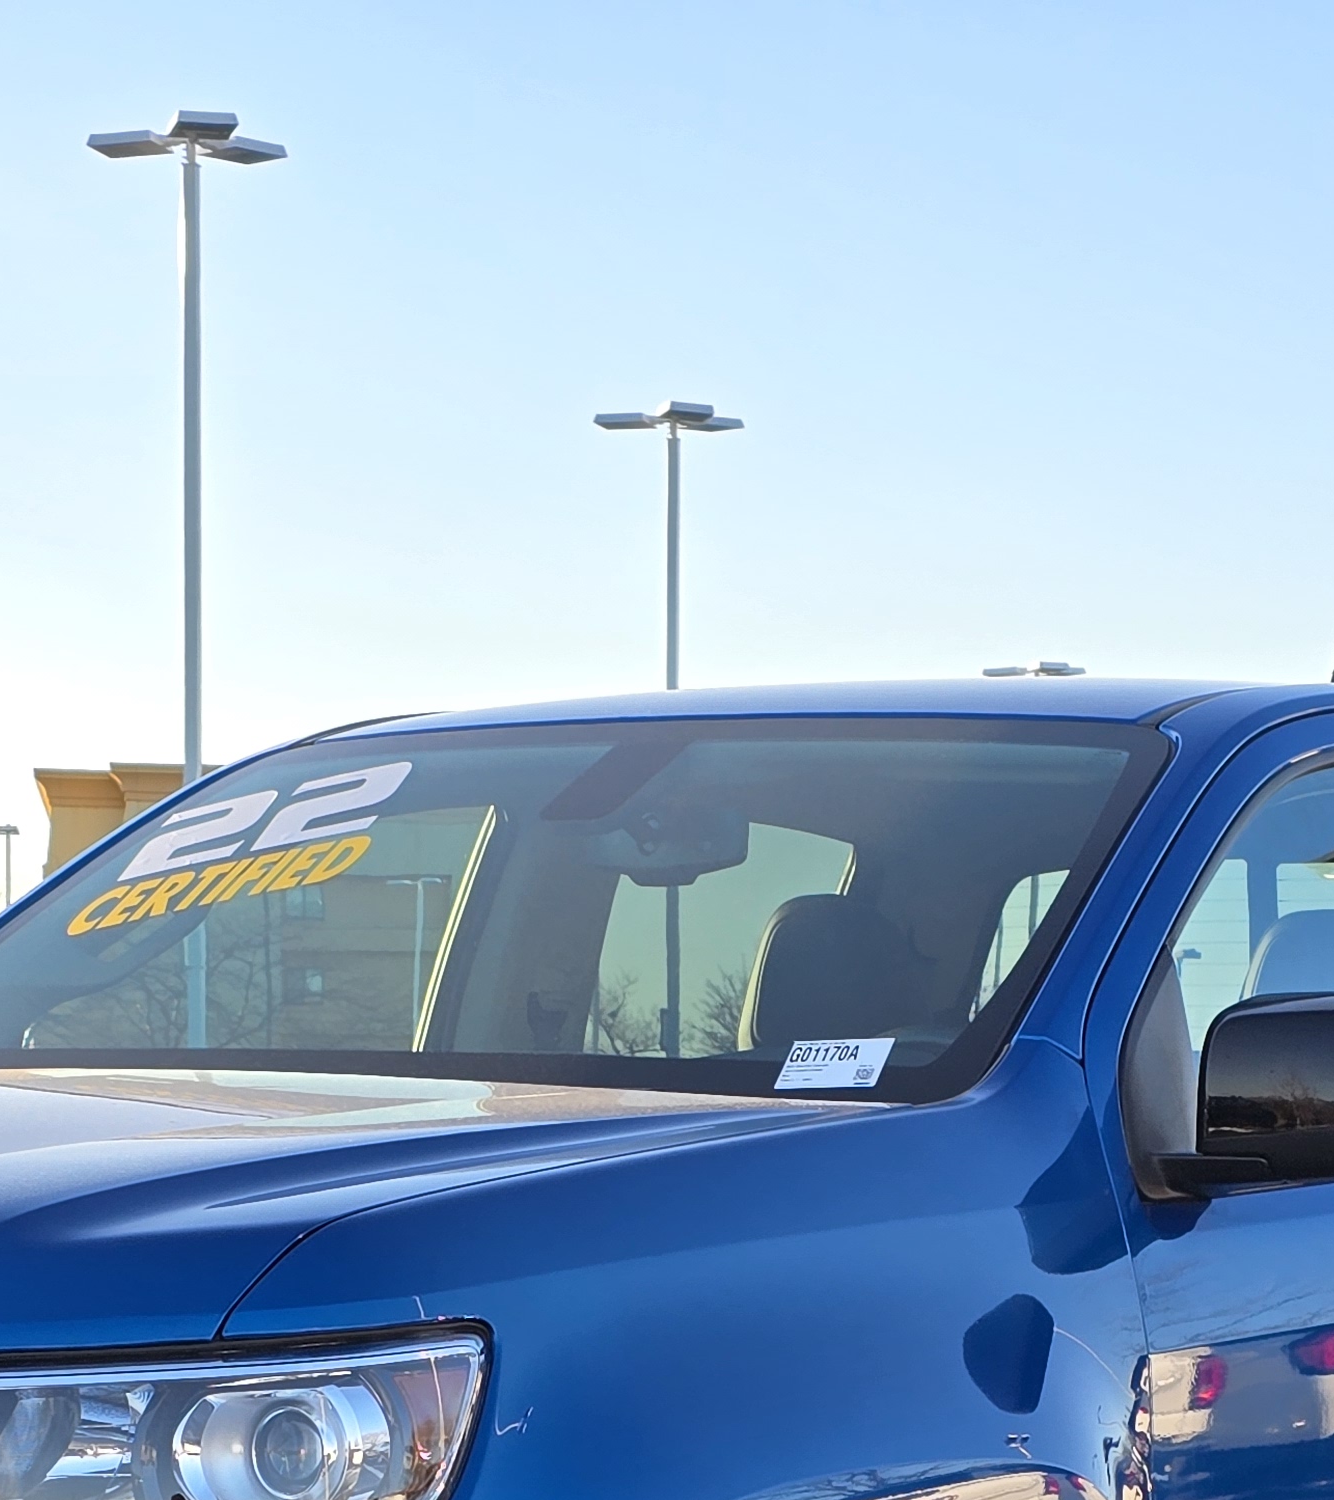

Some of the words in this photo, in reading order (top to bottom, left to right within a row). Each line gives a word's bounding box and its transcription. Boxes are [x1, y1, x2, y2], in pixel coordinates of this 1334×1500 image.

[119, 761, 413, 882] 22
[66, 835, 373, 937] CERTIFIED
[789, 1045, 860, 1063] G01170A
